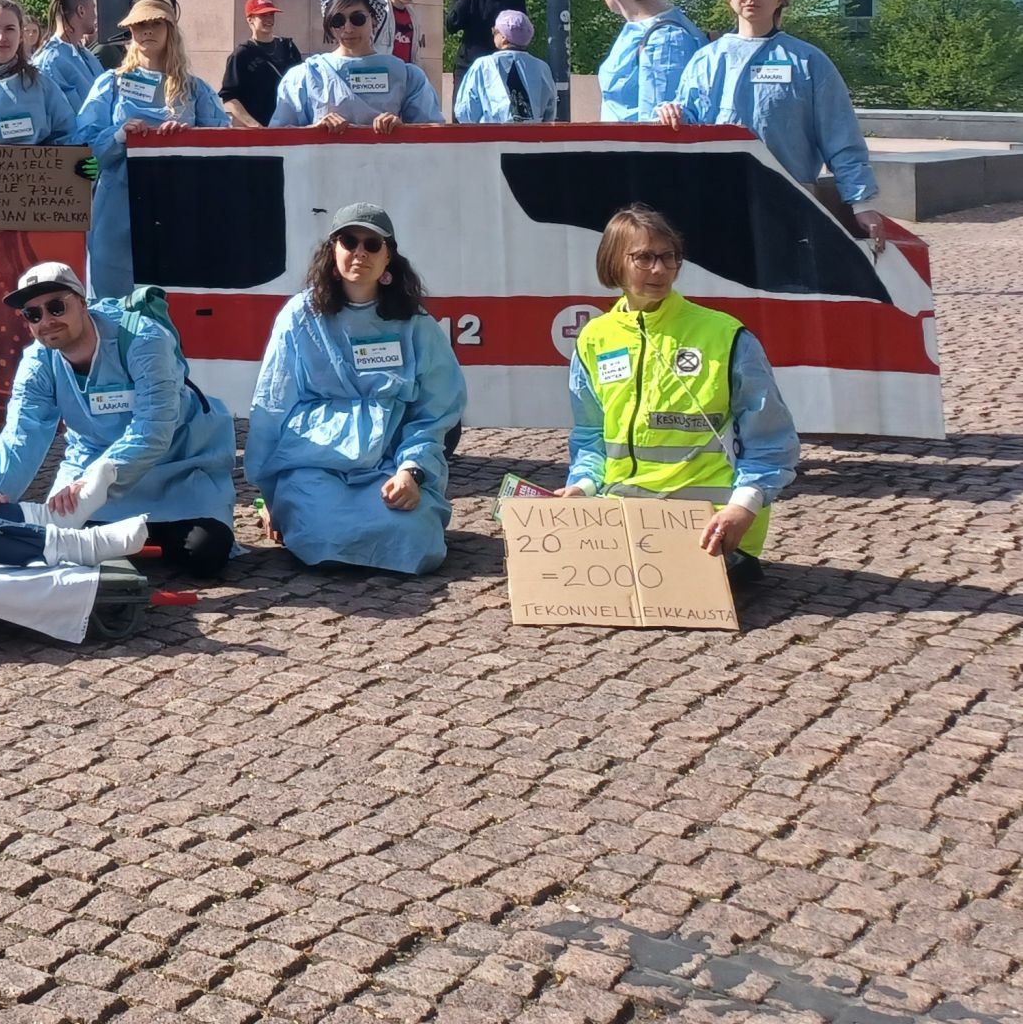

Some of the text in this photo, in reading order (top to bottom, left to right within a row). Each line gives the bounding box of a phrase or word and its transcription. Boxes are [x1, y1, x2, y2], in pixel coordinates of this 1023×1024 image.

[19, 147, 59, 159] TUKI
[28, 185, 74, 197] 7341€
[20, 197, 81, 208] SAIRAAN-
[32, 212, 89, 224] KK-PALKKA
[357, 355, 399, 365] PSYKOLOGI
[511, 506, 623, 528] VIKING
[639, 508, 706, 530] LINE
[516, 534, 663, 554] 20 MILJ €
[542, 563, 663, 588] =2000
[521, 602, 736, 621] TEKONIVELLEIKKAUSTA
